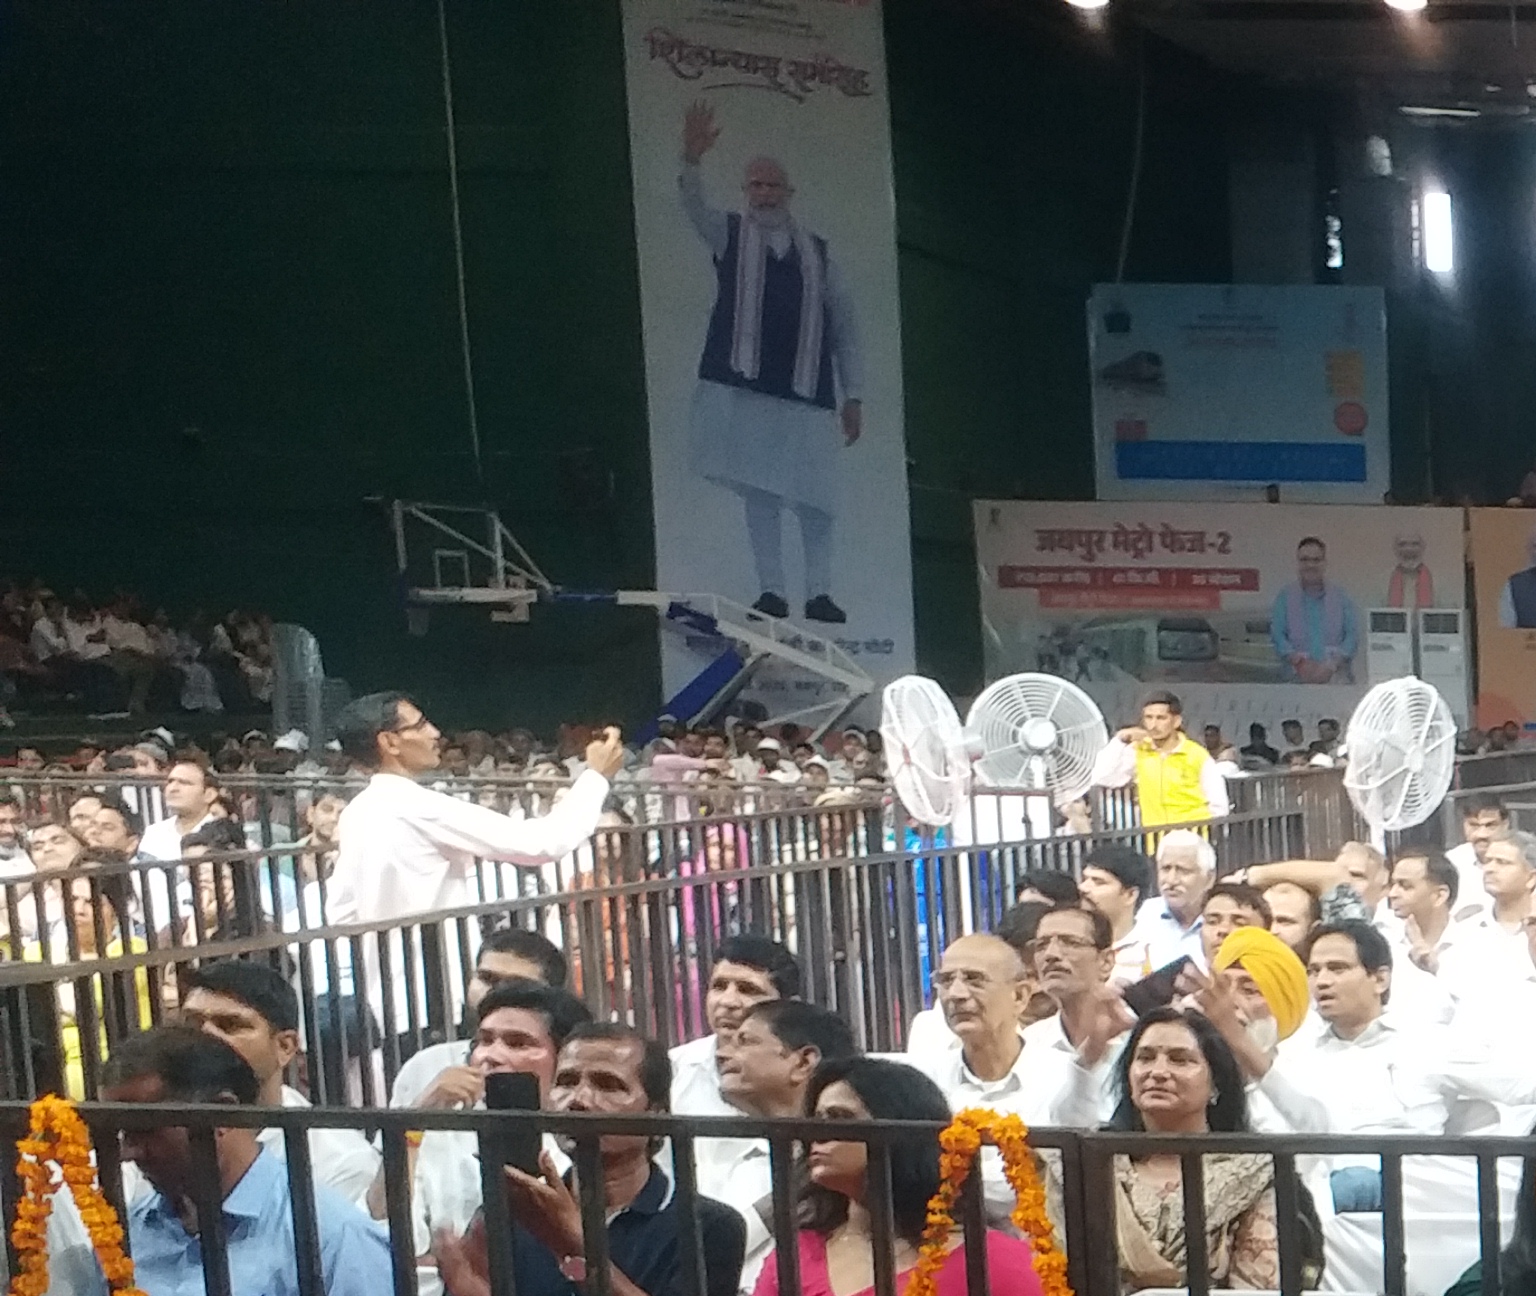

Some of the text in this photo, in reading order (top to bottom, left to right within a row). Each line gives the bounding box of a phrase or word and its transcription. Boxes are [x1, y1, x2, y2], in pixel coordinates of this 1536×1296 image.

[1034, 522, 1233, 562] जयपुर मेट्रो फेज-2
